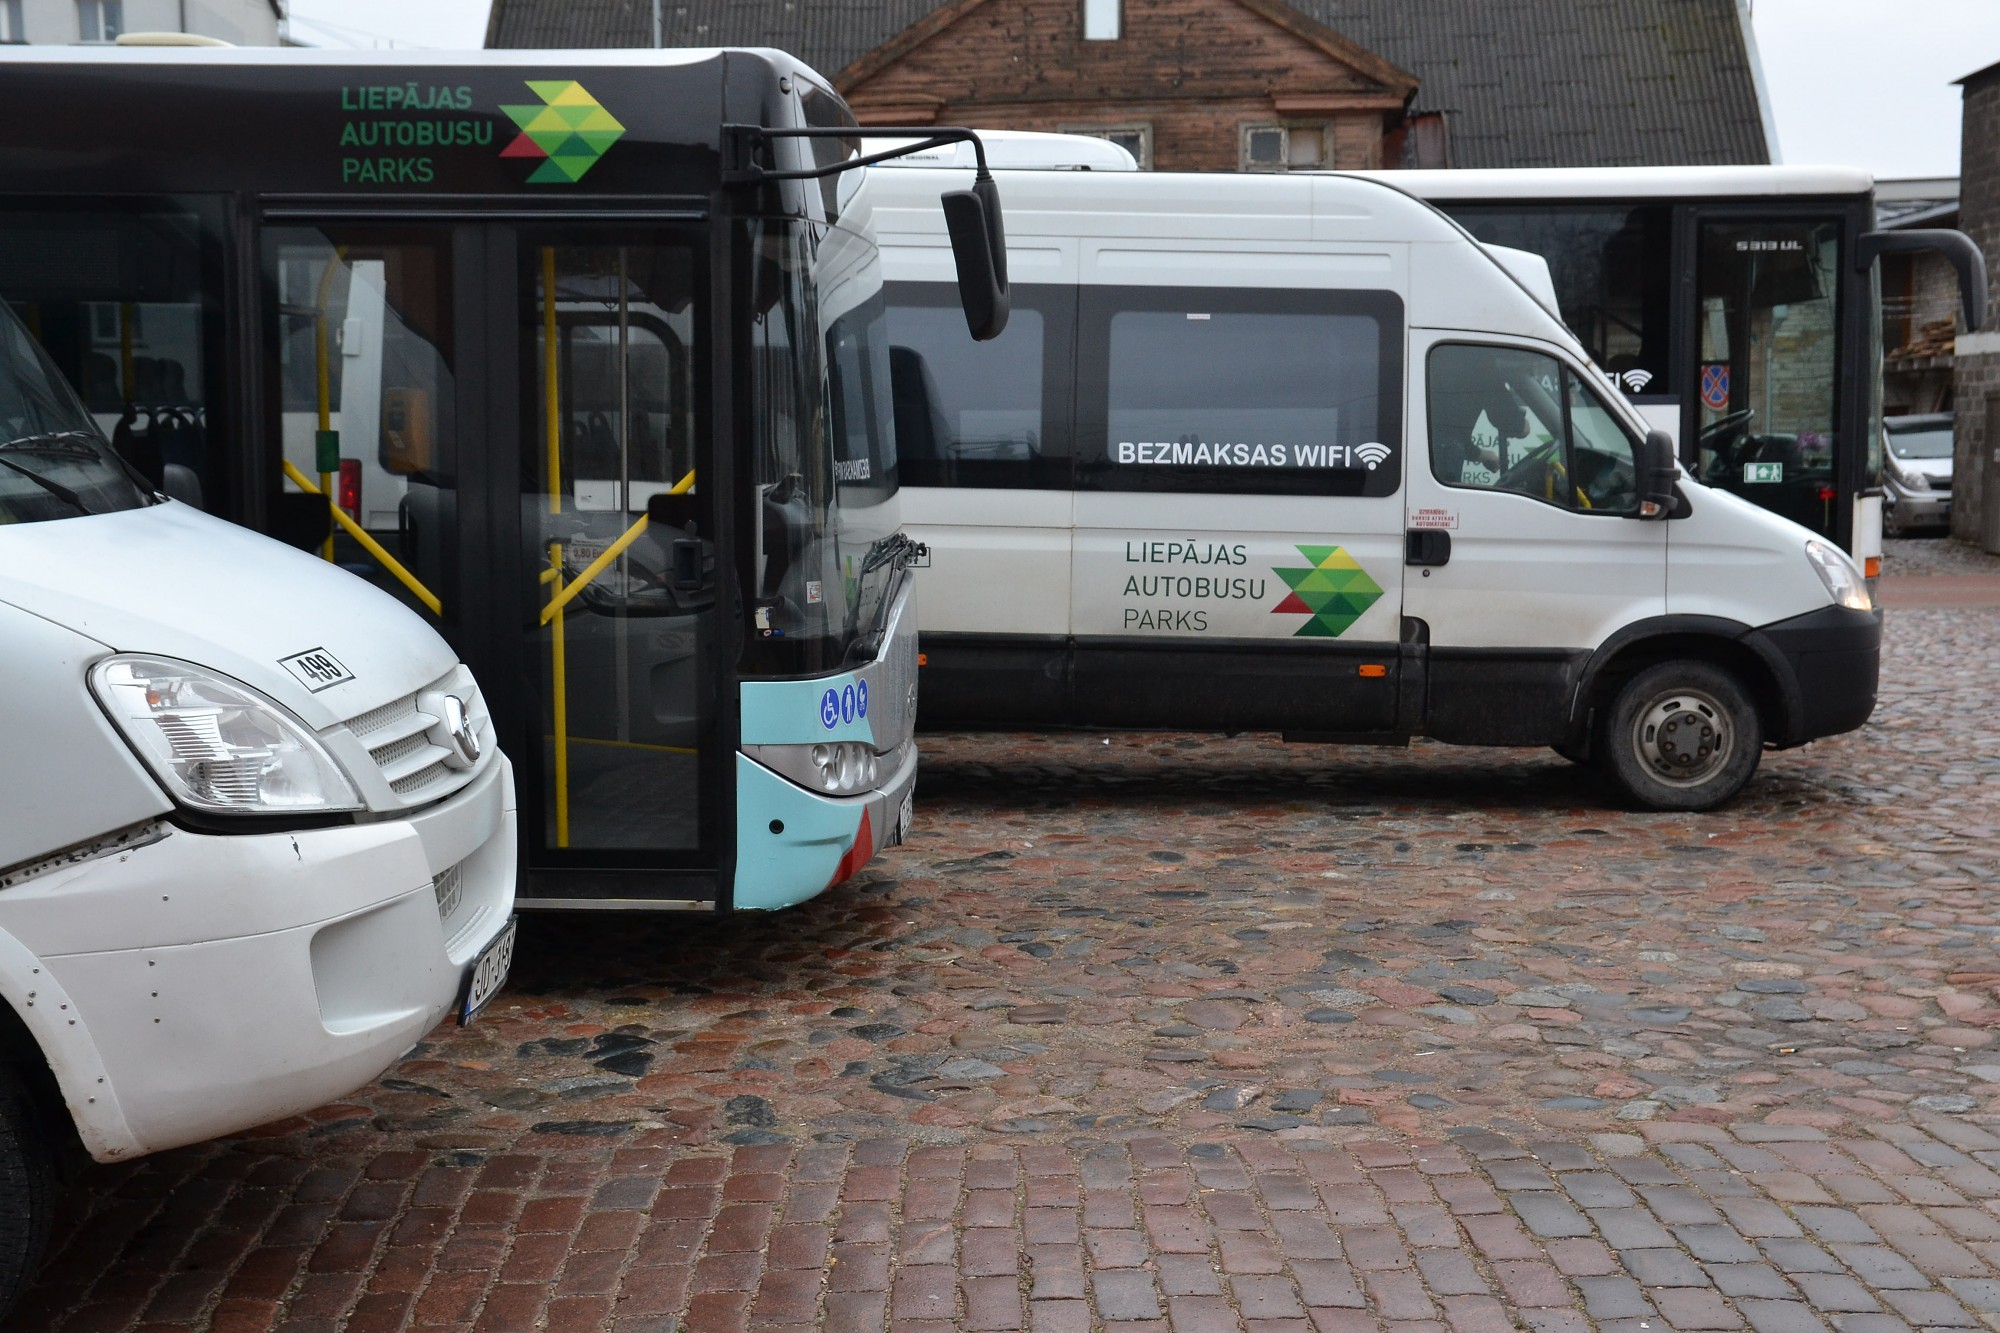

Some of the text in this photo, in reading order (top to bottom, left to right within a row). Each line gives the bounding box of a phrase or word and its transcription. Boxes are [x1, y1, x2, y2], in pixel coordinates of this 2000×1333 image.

[341, 82, 473, 110] LIEPĀJAS
[339, 120, 493, 146] AUTOBUSU
[342, 157, 435, 183] PARKS
[1118, 442, 1351, 468] BEZMAKSAS WIFI
[1126, 539, 1247, 565] LIEPĀJAS
[1123, 575, 1266, 600] AUTOBUSU
[1124, 609, 1208, 631] PARKS
[296, 654, 342, 683] 499
